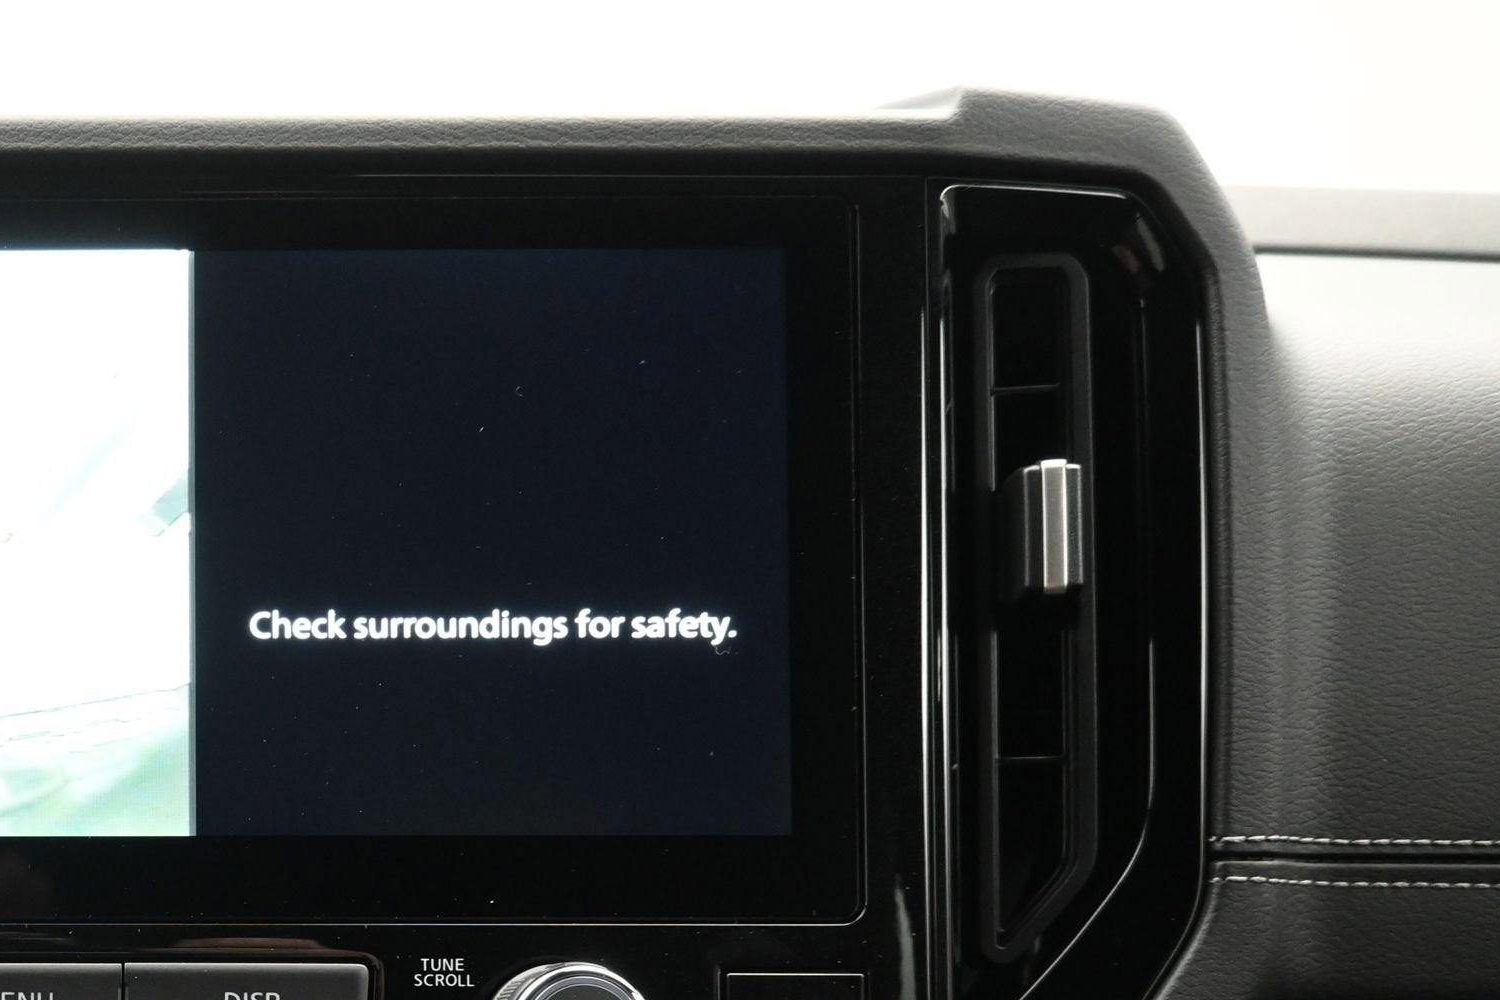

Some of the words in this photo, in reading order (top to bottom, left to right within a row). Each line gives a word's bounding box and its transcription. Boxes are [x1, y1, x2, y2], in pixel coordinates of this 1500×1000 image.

[248, 610, 346, 640] Check
[353, 609, 568, 645] surroundings
[575, 608, 624, 638] for
[630, 608, 738, 643] safety.
[420, 957, 464, 971] TUNE
[413, 973, 475, 988] SCROLL
